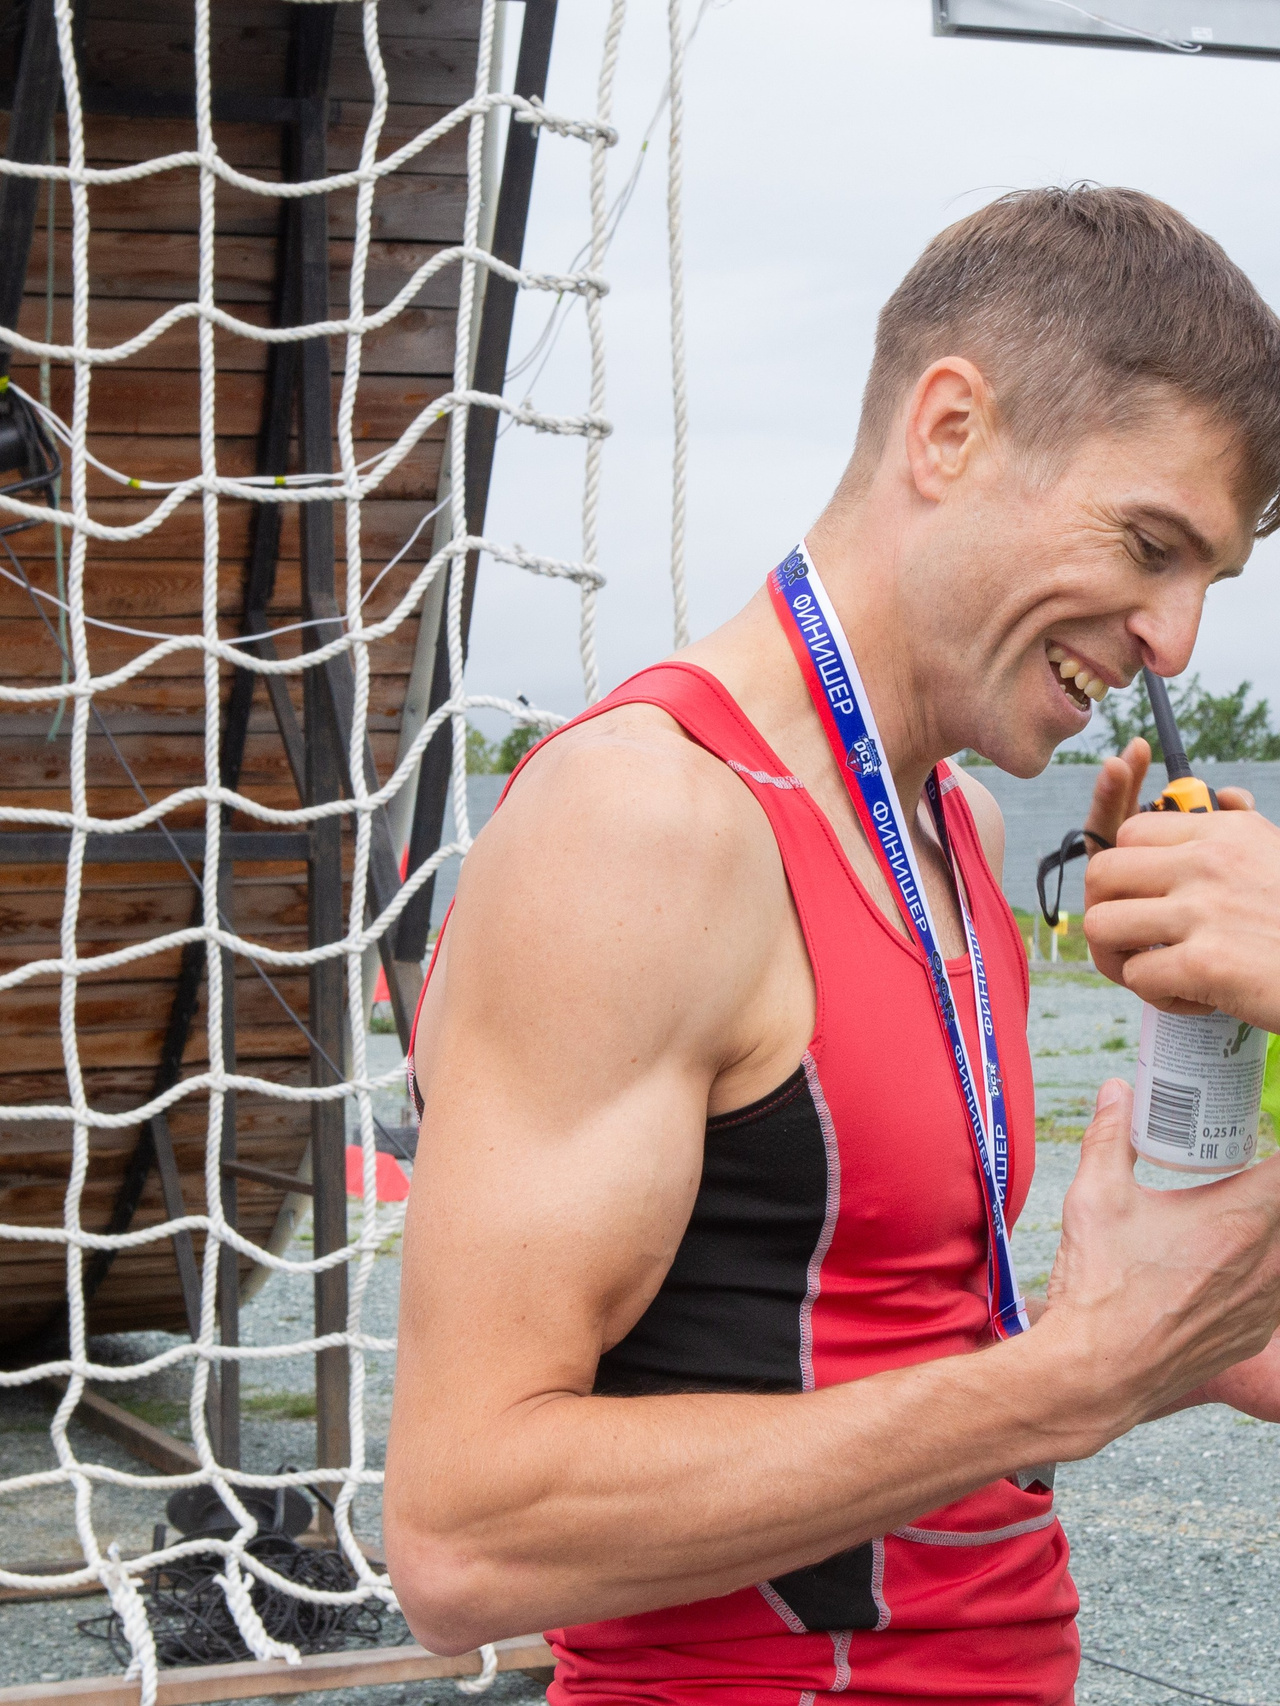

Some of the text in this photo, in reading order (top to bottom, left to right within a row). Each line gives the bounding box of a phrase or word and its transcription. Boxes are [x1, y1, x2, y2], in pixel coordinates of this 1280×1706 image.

[792, 593, 854, 715] ФИНИШЕР
[853, 740, 875, 775] OCR
[872, 801, 927, 932] ФИНИШЕР
[931, 950, 955, 1026] OCR
[966, 915, 993, 1036] ФИНИШ
[954, 1044, 990, 1176] ФИНИШЕР
[1202, 1127, 1227, 1139] 0,25
[995, 1124, 1008, 1206] ИШЕР
